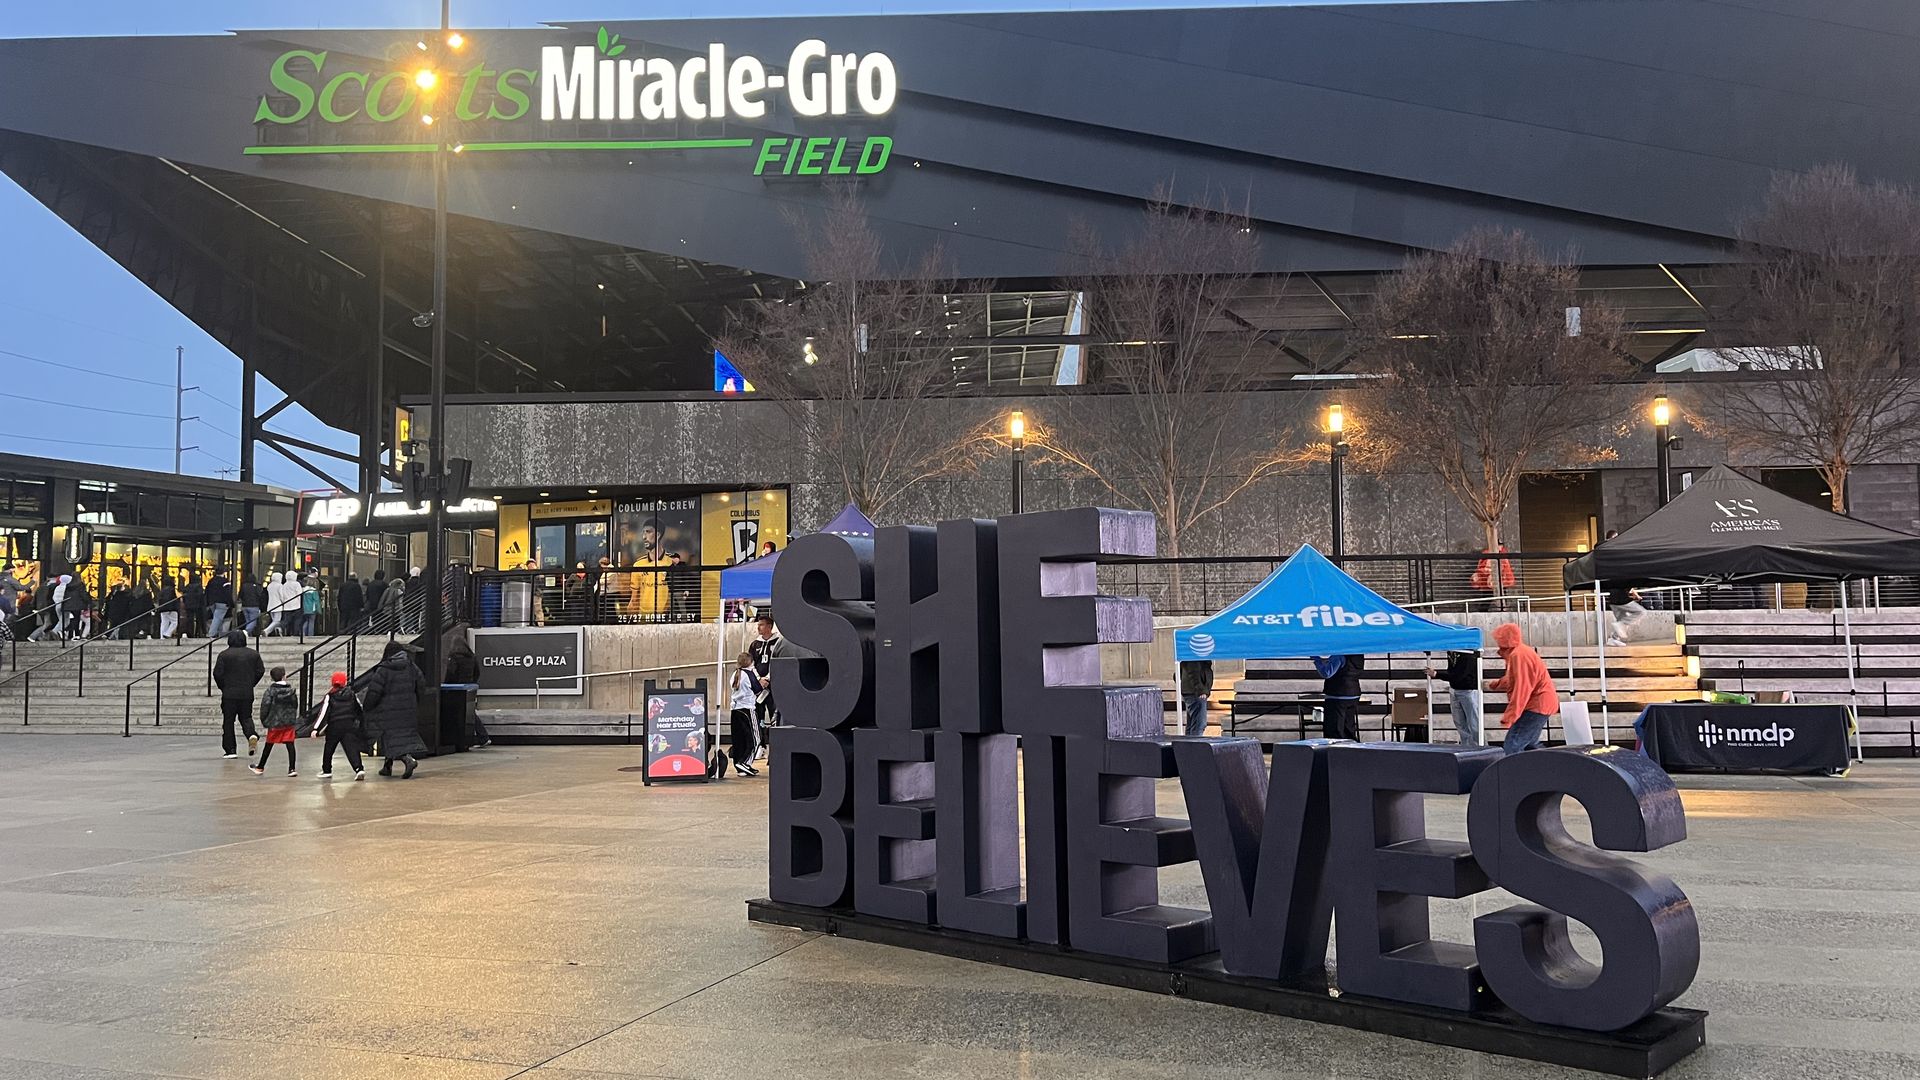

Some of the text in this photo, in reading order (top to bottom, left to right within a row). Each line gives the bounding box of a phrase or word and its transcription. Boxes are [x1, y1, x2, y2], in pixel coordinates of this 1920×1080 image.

[540, 40, 897, 121] Miracle-Gro
[753, 136, 893, 175] FIELD
[306, 498, 361, 525] AEP
[618, 500, 695, 513] COLUMBUS CREW
[730, 509, 760, 517] COLUBUS
[1710, 519, 1781, 528] AMERICA'S
[355, 537, 397, 554] CONDDO
[770, 508, 1164, 738] SHE
[1232, 605, 1405, 628] AT&T fiber
[483, 655, 567, 666] CHASE PLAZA
[761, 654, 769, 664] 10
[1726, 722, 1795, 747] nmdp
[769, 727, 1700, 1031] BELIEVES
